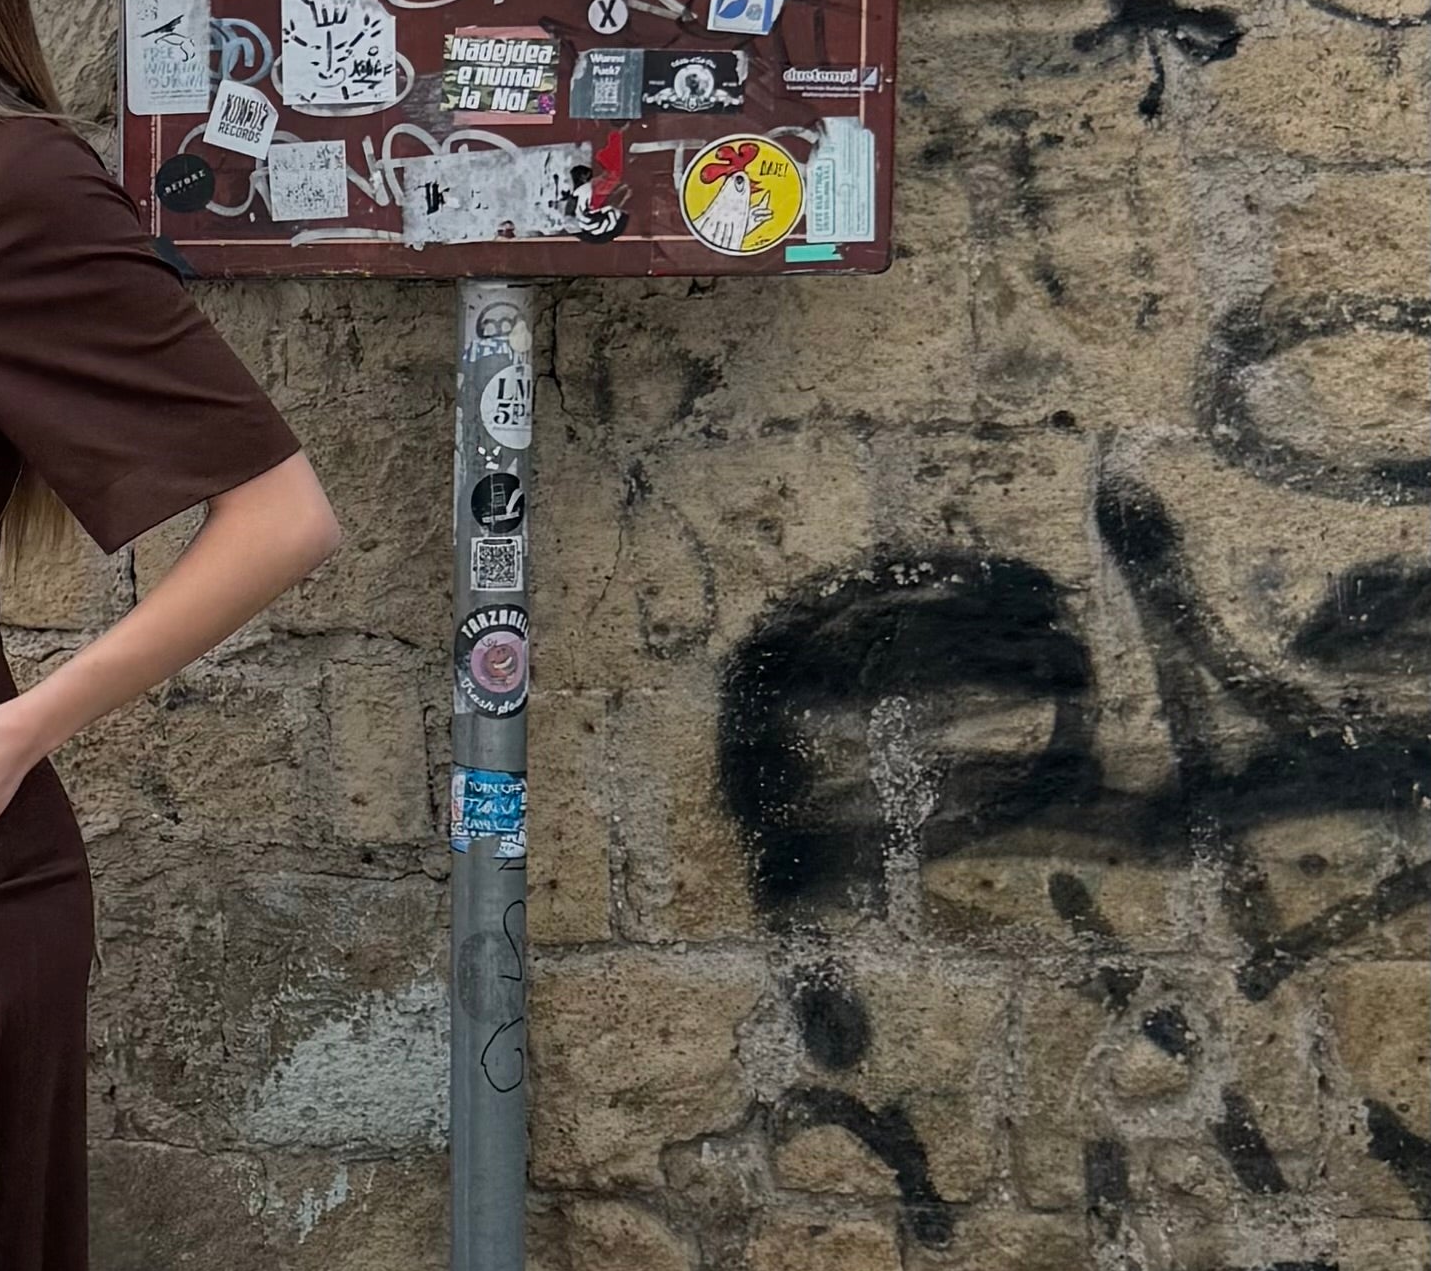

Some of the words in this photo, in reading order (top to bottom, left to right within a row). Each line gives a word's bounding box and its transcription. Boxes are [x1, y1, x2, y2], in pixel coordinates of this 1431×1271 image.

[450, 36, 554, 66] Nadejdea
[457, 69, 471, 85] e
[474, 65, 544, 89] numai
[459, 88, 481, 110] la
[490, 87, 530, 112] Noi
[217, 121, 261, 144] RECORDS
